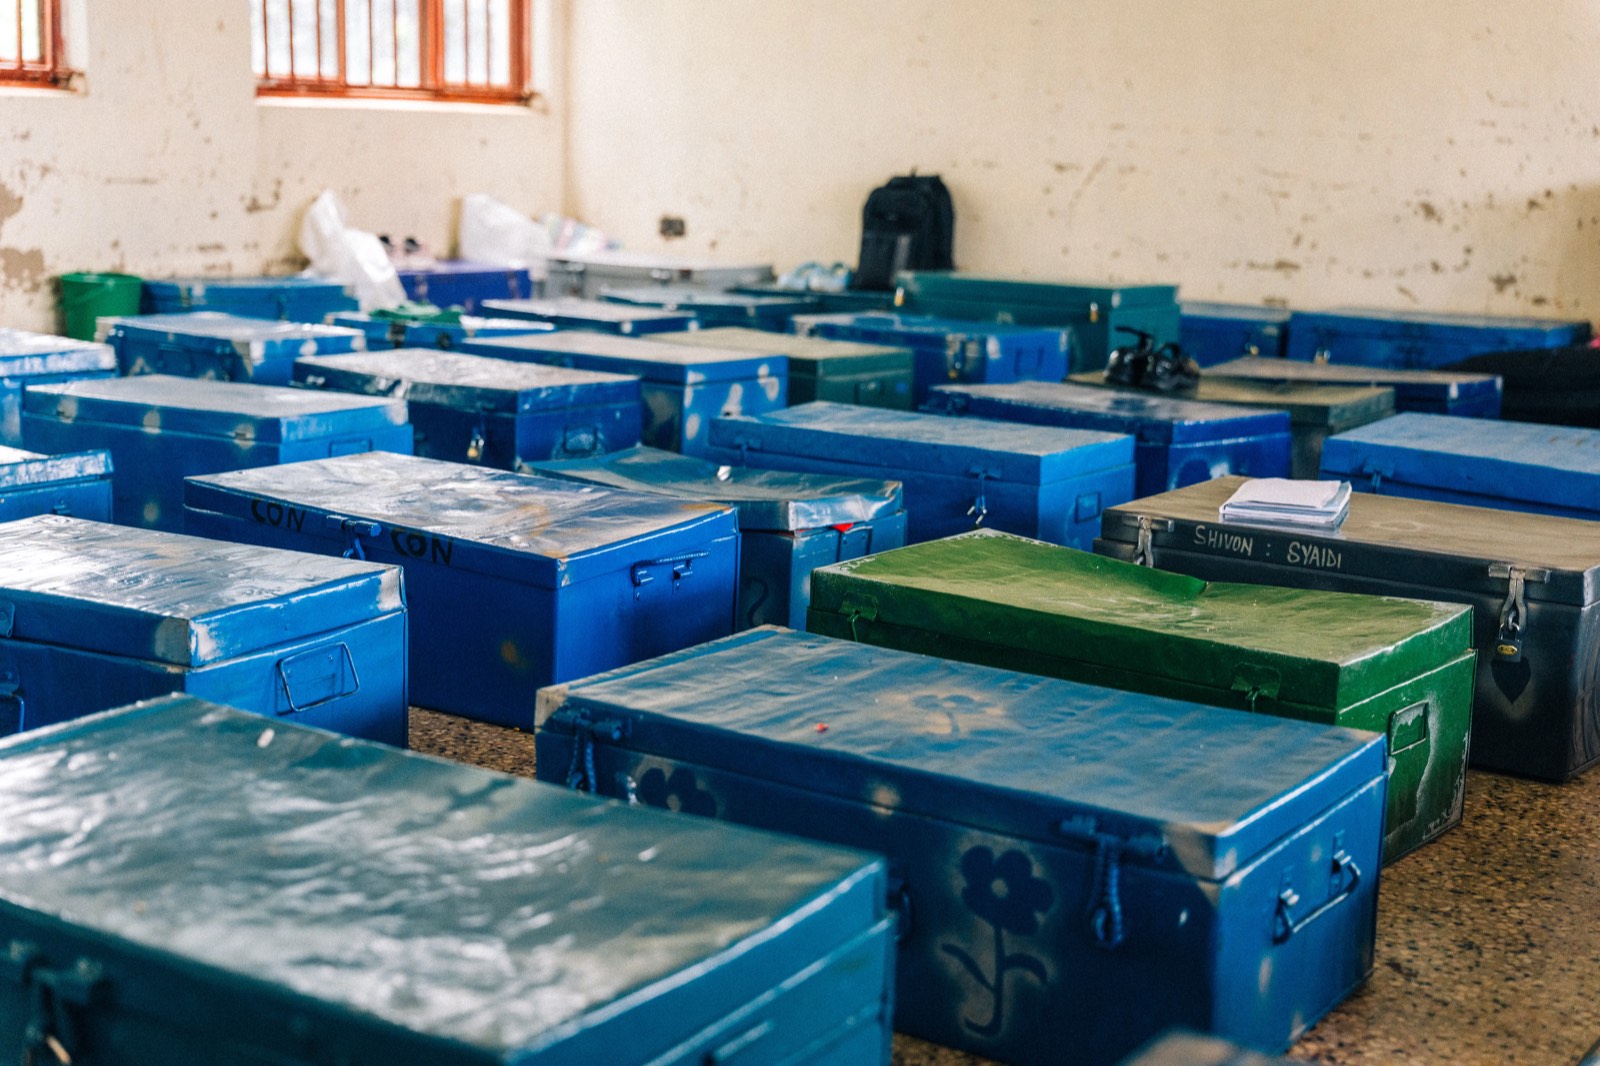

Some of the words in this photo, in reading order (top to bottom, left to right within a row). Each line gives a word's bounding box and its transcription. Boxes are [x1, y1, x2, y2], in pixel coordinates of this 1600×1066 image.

[251, 499, 306, 532] CON
[391, 528, 454, 565] CON
[1194, 525, 1253, 556] SHIVON
[1287, 541, 1342, 569] SYAIDI
